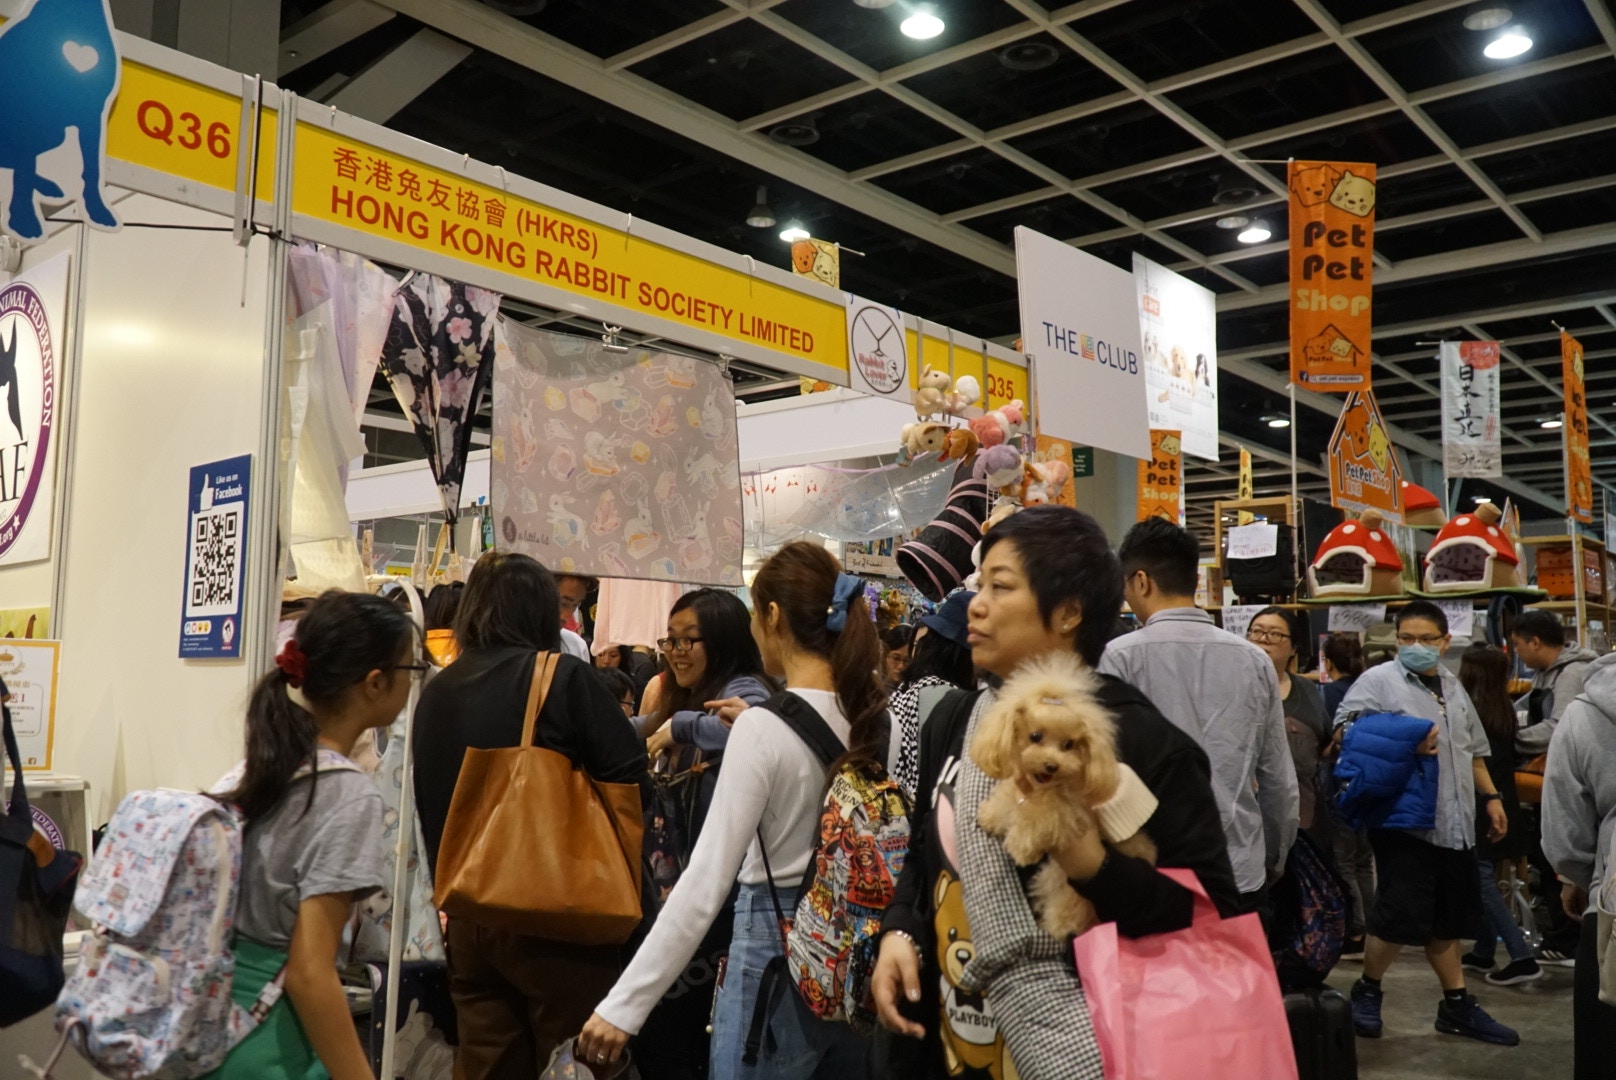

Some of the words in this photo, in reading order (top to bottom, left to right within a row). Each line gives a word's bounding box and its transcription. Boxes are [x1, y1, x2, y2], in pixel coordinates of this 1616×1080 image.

[137, 99, 231, 158] Q36
[333, 146, 507, 228] 香港兔友協會
[516, 208, 598, 259] (HKRS)
[1303, 221, 1366, 248] Pet
[331, 186, 429, 240] HONG
[440, 220, 526, 268] KONG
[536, 249, 631, 300] RABBIT
[638, 282, 733, 330] SOCIETY
[739, 313, 814, 353] LIMITED
[1302, 254, 1364, 281] Pet
[1296, 288, 1370, 317] Shop
[28, 296, 52, 426] FEDERATION
[1042, 321, 1078, 356] THE
[1097, 340, 1138, 375] CLUB
[988, 373, 1014, 400] Q35
[1147, 458, 1176, 470] Pet
[215, 476, 225, 484] Like
[215, 483, 243, 500] Facebook
[1147, 473, 1176, 486] Pet
[1142, 487, 1178, 503] Shop
[950, 1008, 995, 1028] PLAYBOY
